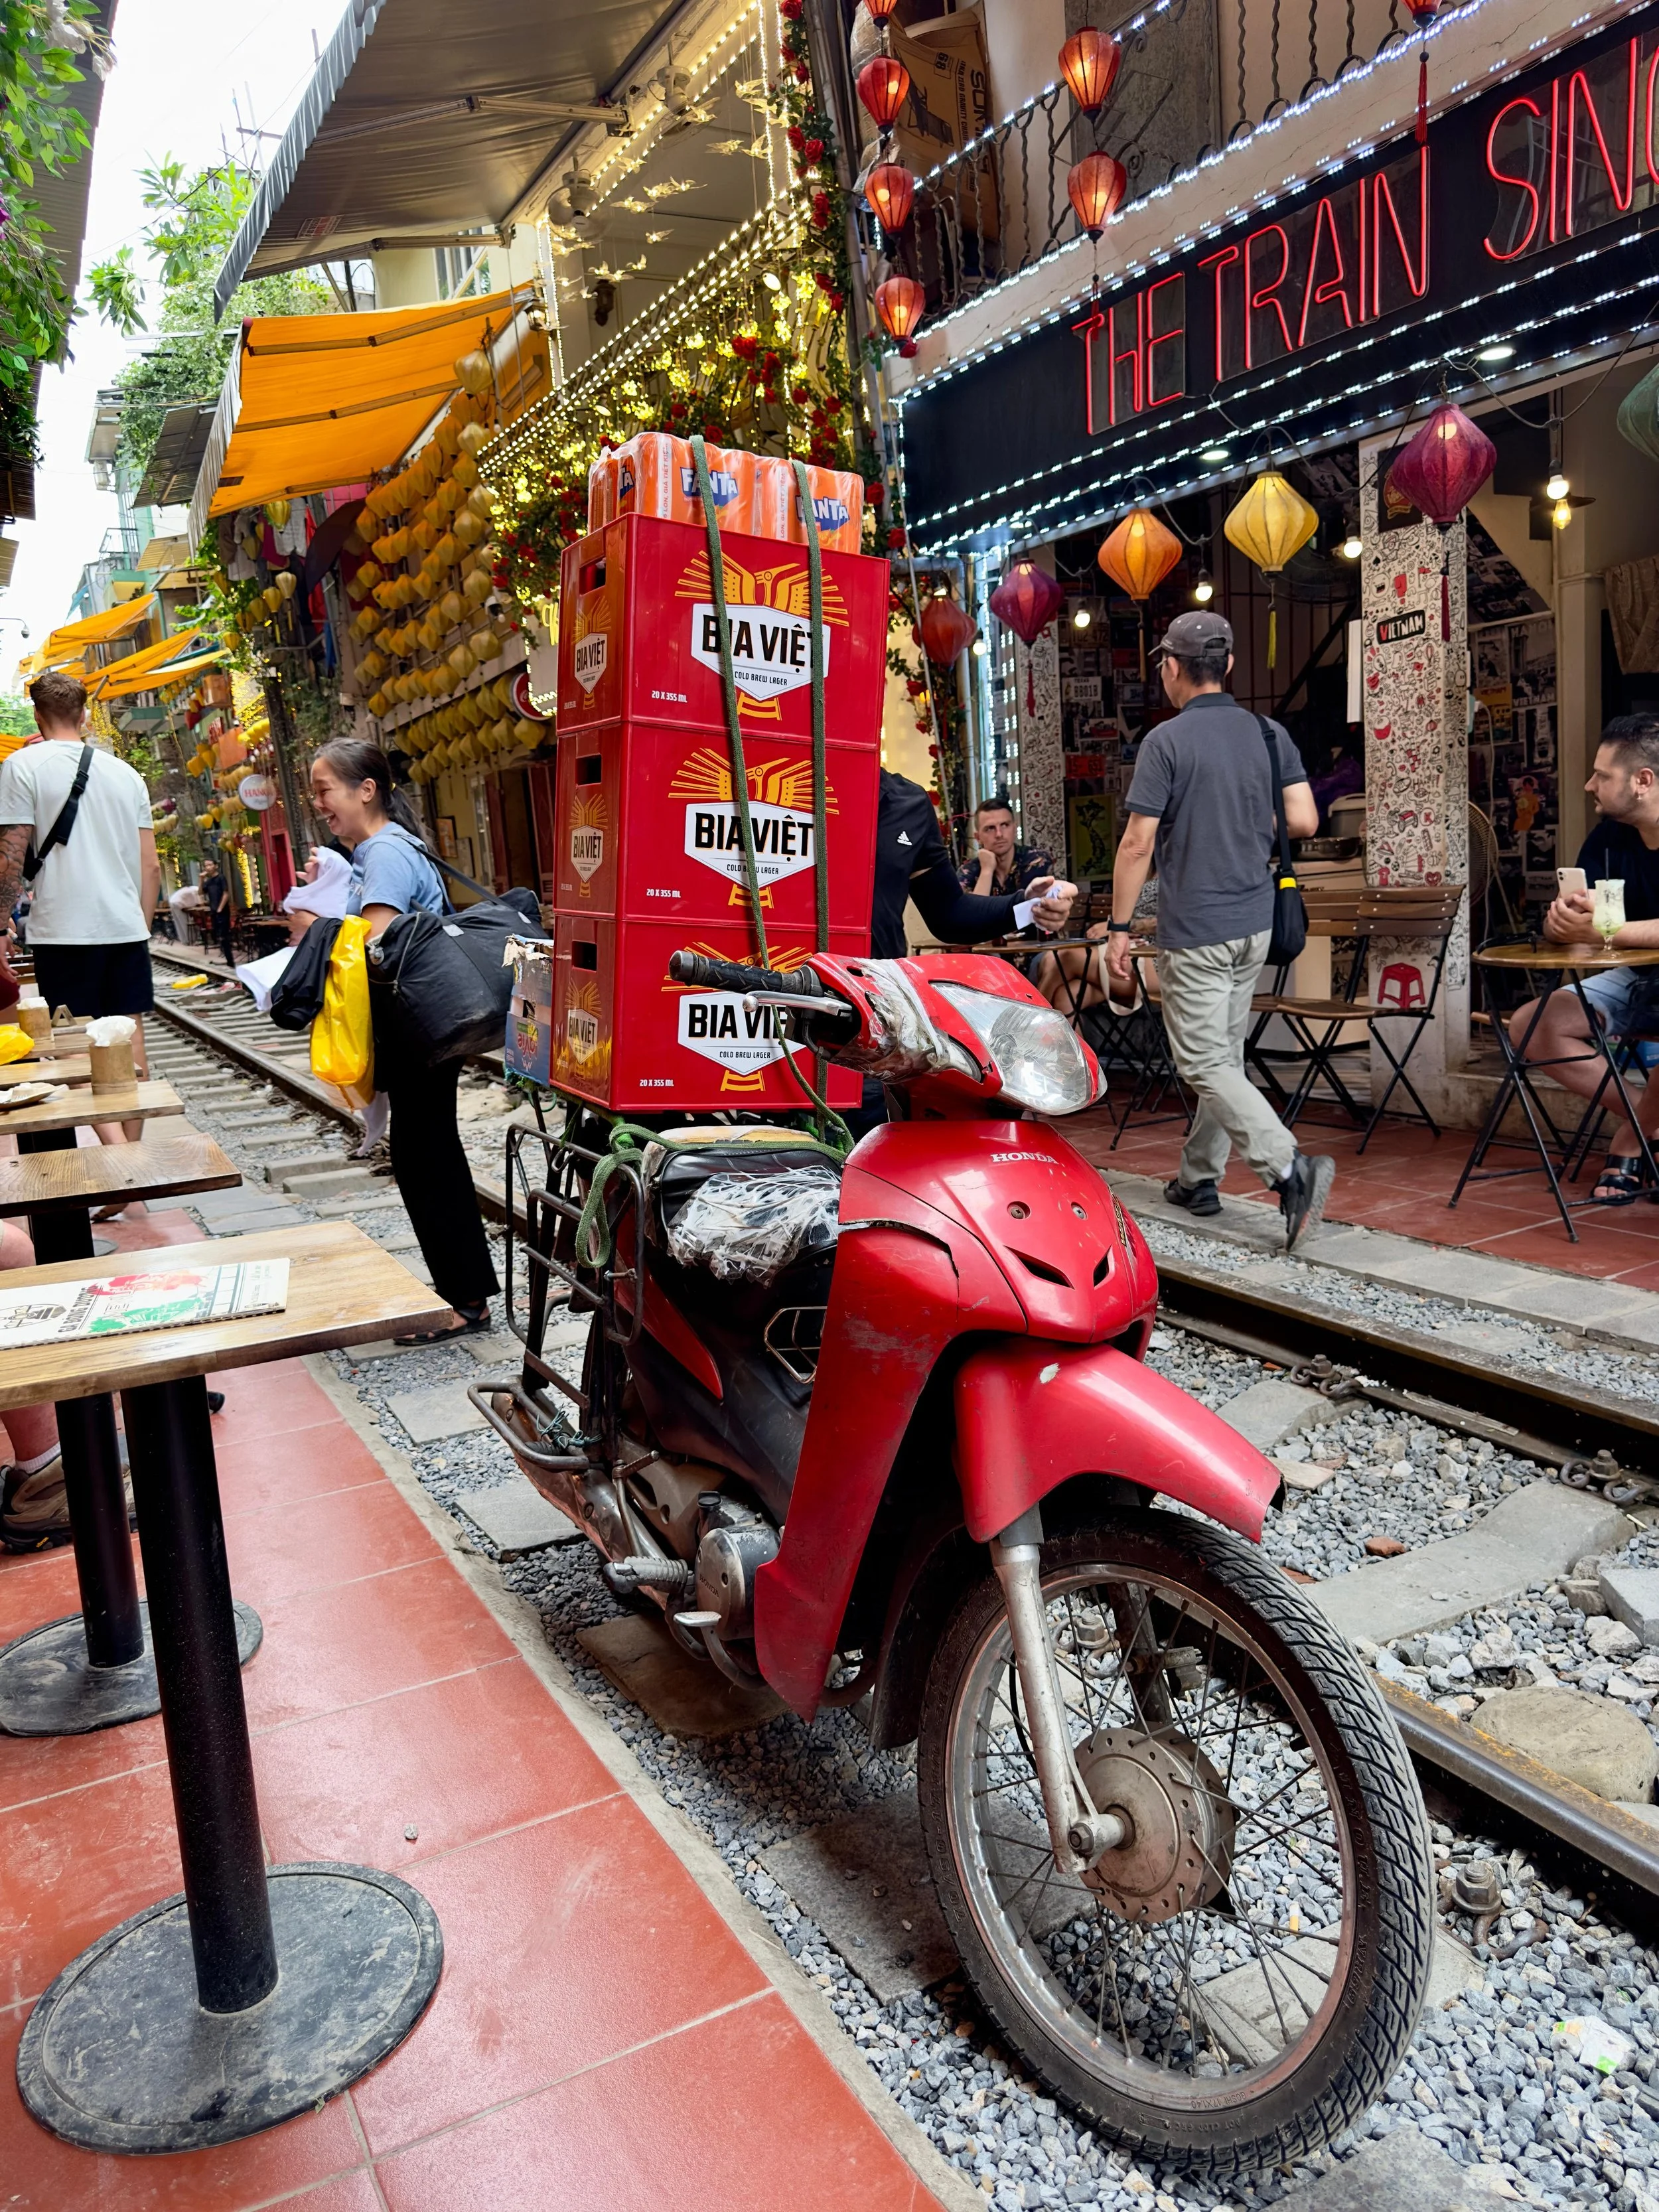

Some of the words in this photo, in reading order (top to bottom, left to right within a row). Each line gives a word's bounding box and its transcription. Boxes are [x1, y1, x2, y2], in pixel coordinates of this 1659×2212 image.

[958, 92, 968, 120] GRAVITY
[1072, 271, 1185, 435] THE
[1198, 146, 1429, 382] TRAIN
[1484, 36, 1659, 261] SIN
[1380, 615, 1423, 641] VIETNAM
[576, 646, 588, 672] BIA
[735, 671, 749, 680] COLD
[751, 674, 768, 683] BREW
[769, 677, 788, 686] LAGER
[652, 690, 660, 699] 20
[660, 691, 666, 700] X
[666, 692, 678, 701] 355
[573, 835, 585, 858] BIA
[695, 812, 745, 852] BIA
[750, 814, 814, 862] VIỆT
[761, 866, 779, 875] LAGER
[568, 1016, 579, 1038] BIA
[688, 1003, 738, 1039] BIA
[991, 1151, 1058, 1164] HONDA
